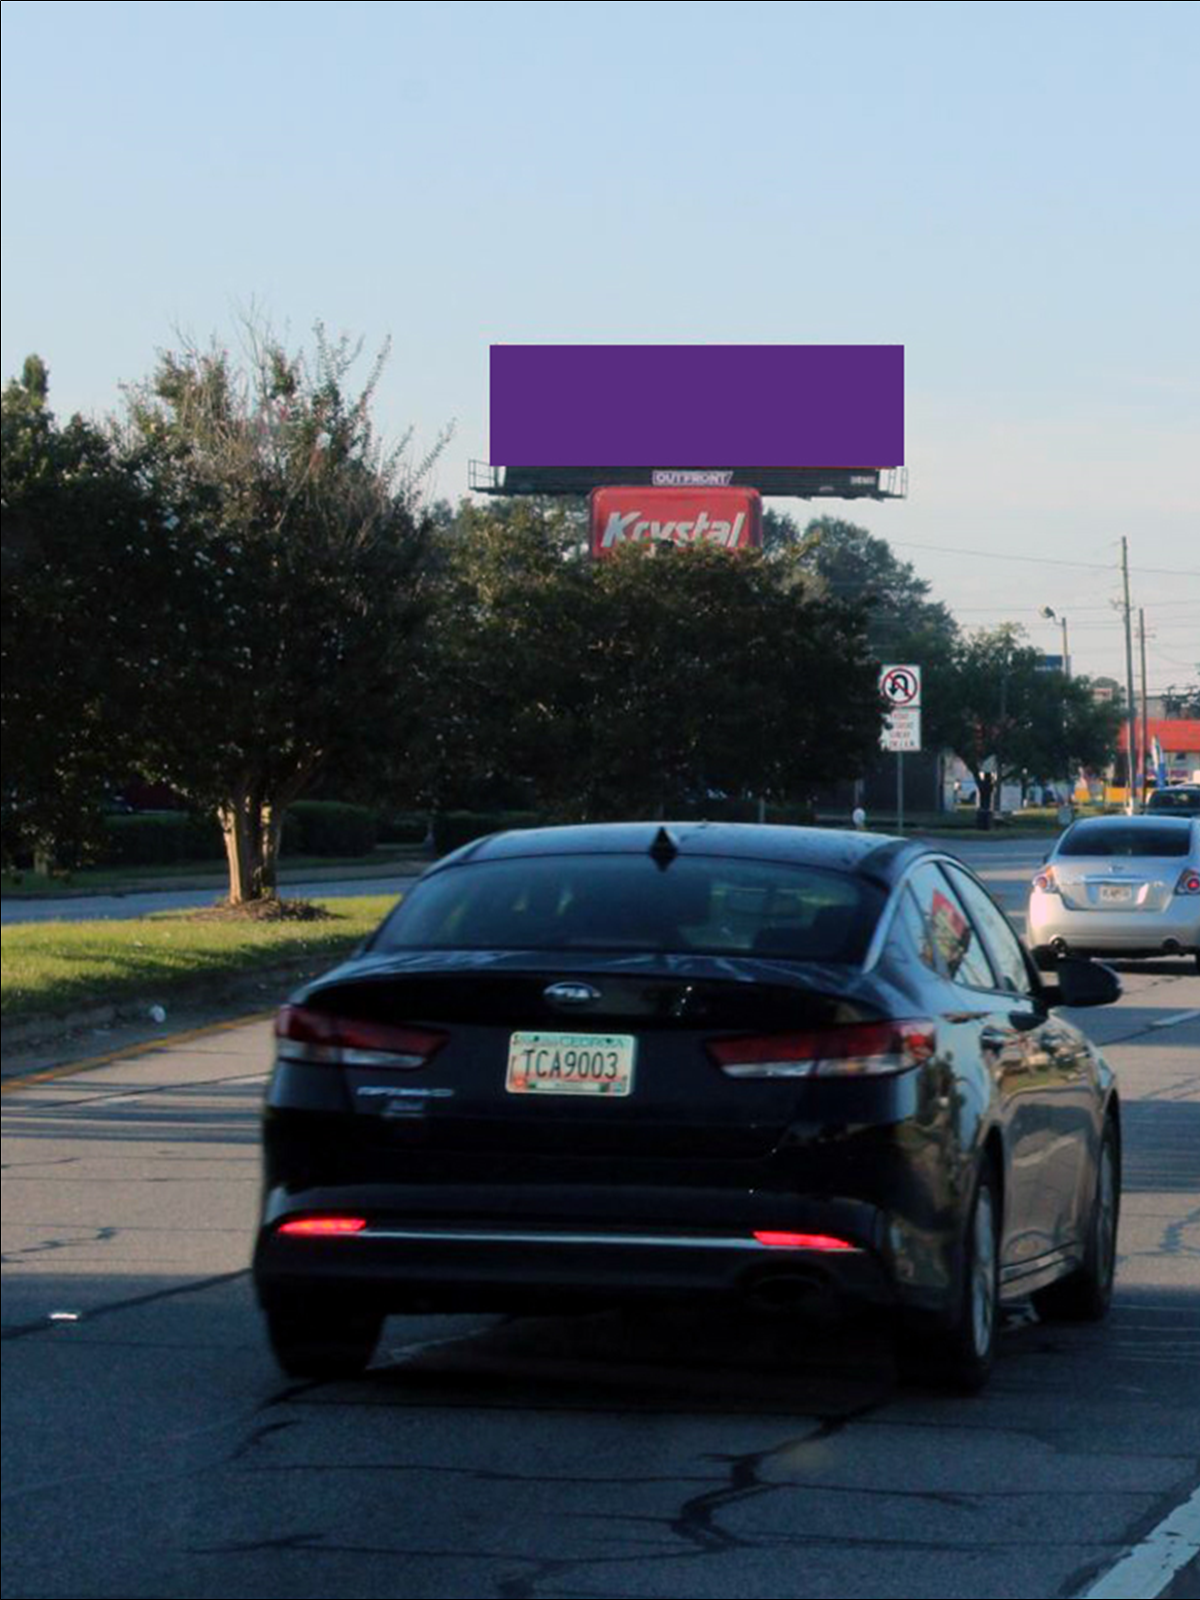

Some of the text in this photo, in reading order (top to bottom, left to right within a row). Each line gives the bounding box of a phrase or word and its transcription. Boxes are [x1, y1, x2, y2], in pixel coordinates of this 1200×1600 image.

[657, 473, 729, 484] OUTFRONT
[601, 511, 746, 548] Krystal
[522, 1048, 619, 1080] TCA9003
